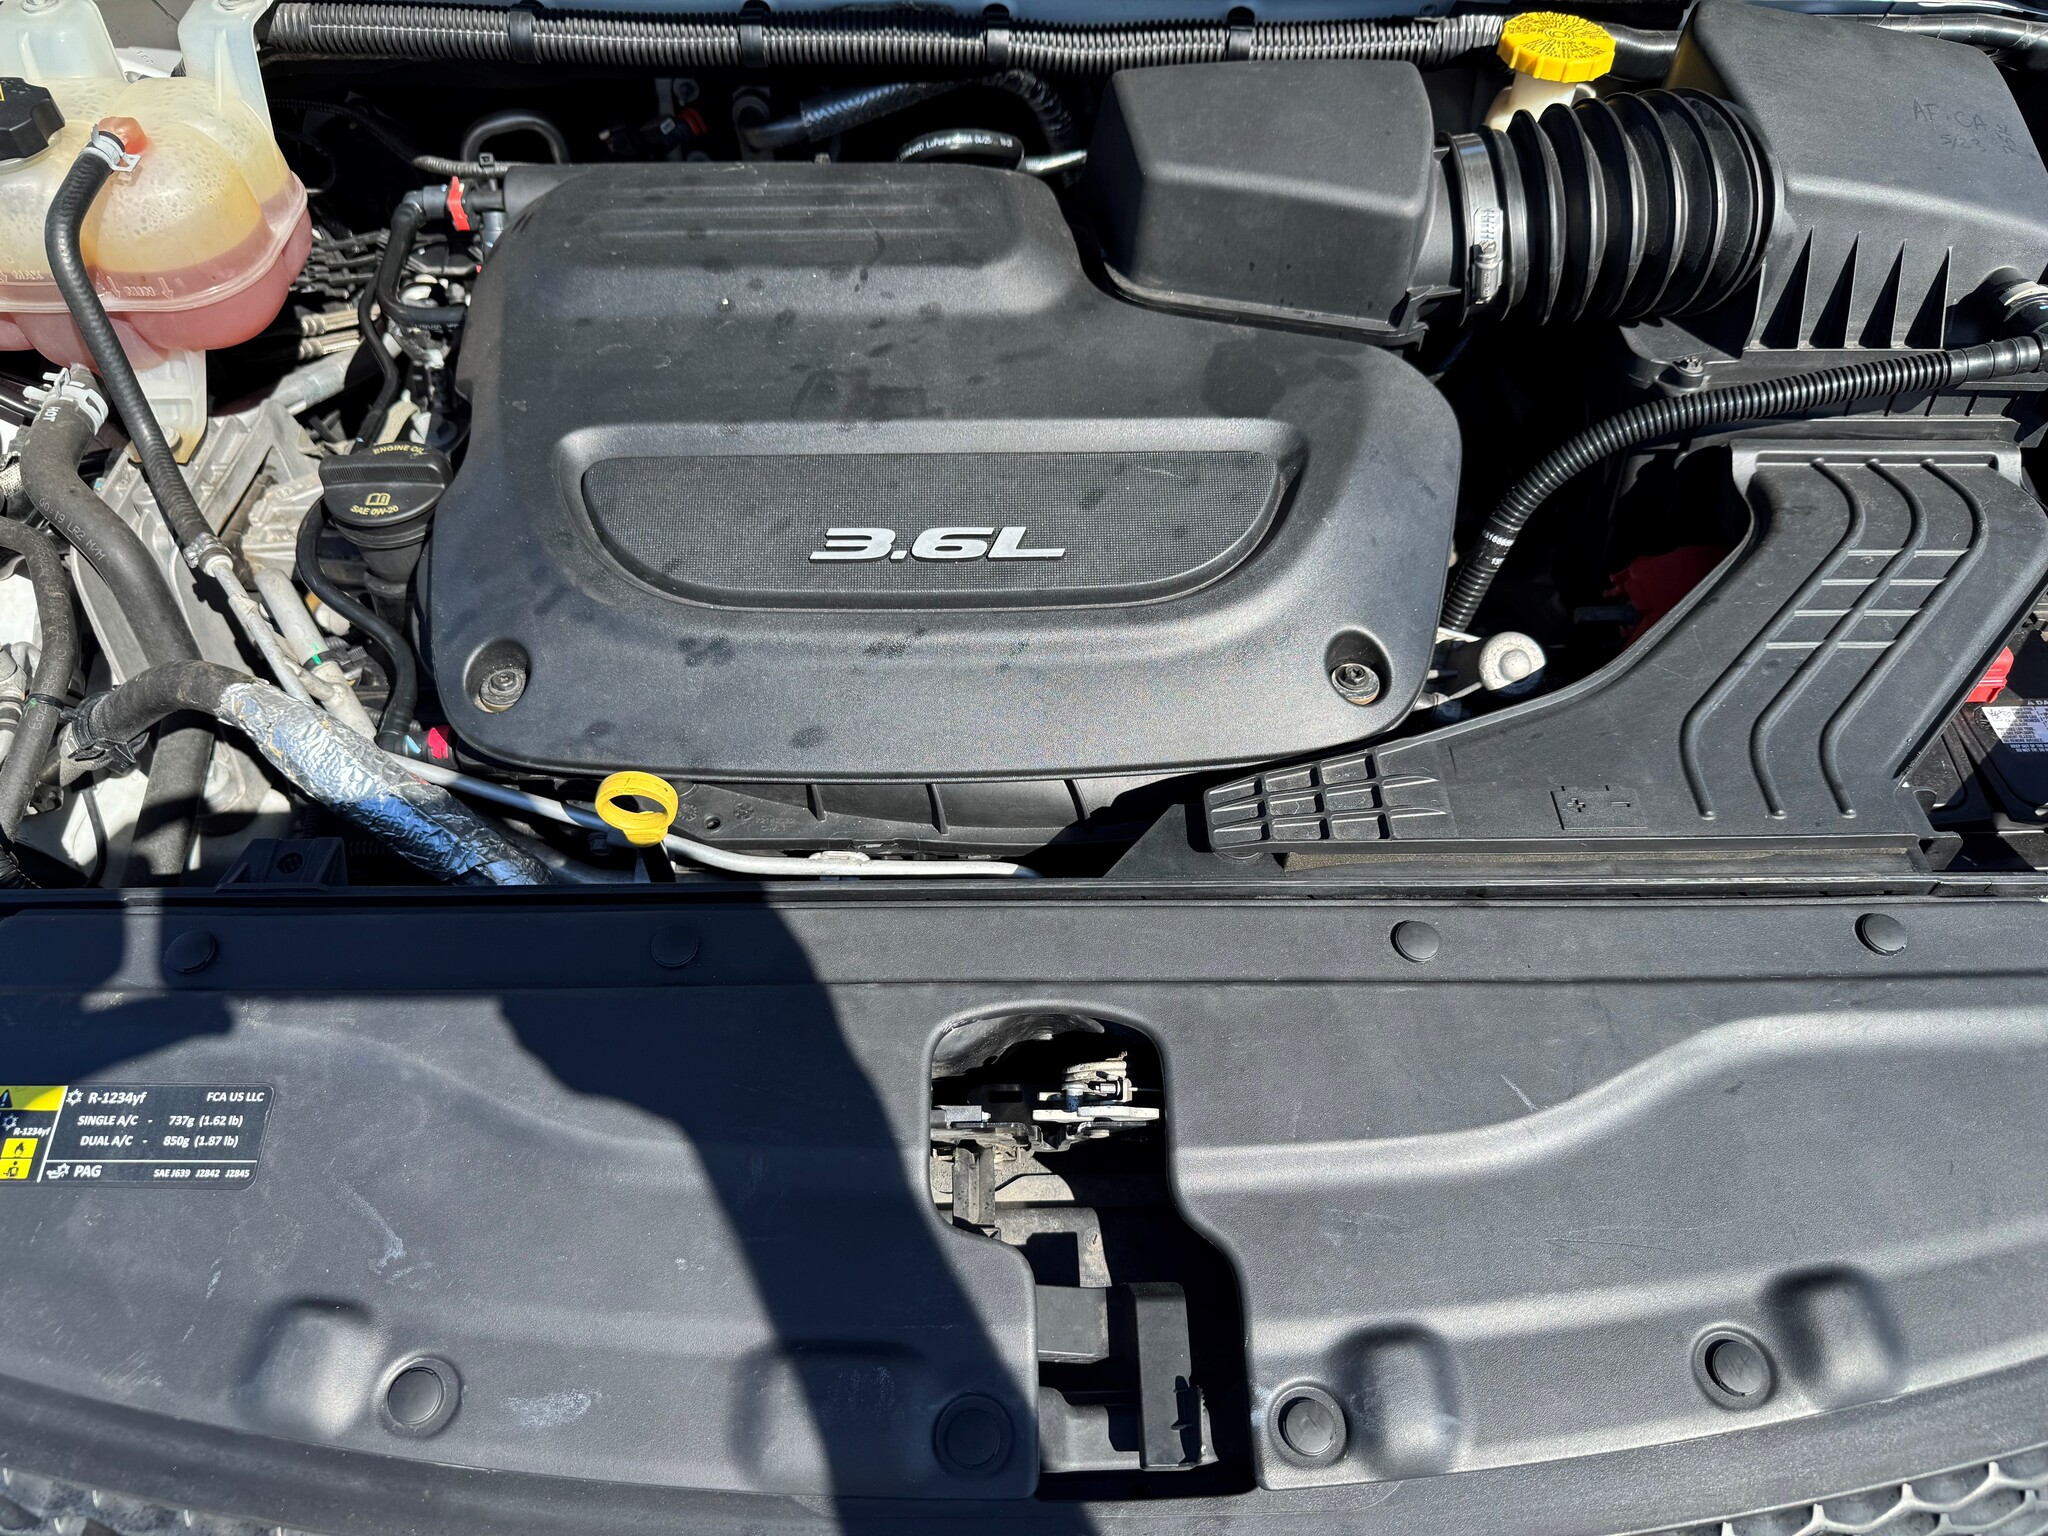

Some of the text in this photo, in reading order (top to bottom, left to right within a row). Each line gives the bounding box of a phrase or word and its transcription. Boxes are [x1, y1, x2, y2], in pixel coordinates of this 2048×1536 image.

[42, 406, 62, 423] HOT
[372, 444, 425, 455] ENGINE OIL
[350, 504, 399, 515] SAE 0W-20
[67, 521, 86, 540] LR2
[808, 526, 1067, 562] 3.6L
[87, 1092, 147, 1106] R-1234yf
[206, 1092, 265, 1102] FCA US LLC
[77, 1115, 116, 1126] SINGLE
[116, 1114, 139, 1127] A/C
[169, 1115, 195, 1128] 737g
[199, 1114, 227, 1128] (1.62
[228, 1115, 244, 1128] lb)
[13, 1126, 52, 1138] R-1234yf
[80, 1135, 110, 1146] DUAL
[111, 1134, 134, 1148] A/C
[162, 1135, 190, 1148] 850g
[194, 1135, 222, 1148] (1.87
[223, 1135, 239, 1148] lb)
[73, 1165, 102, 1178] PAG
[153, 1169, 250, 1178] SAE J639 J2842 J2845
